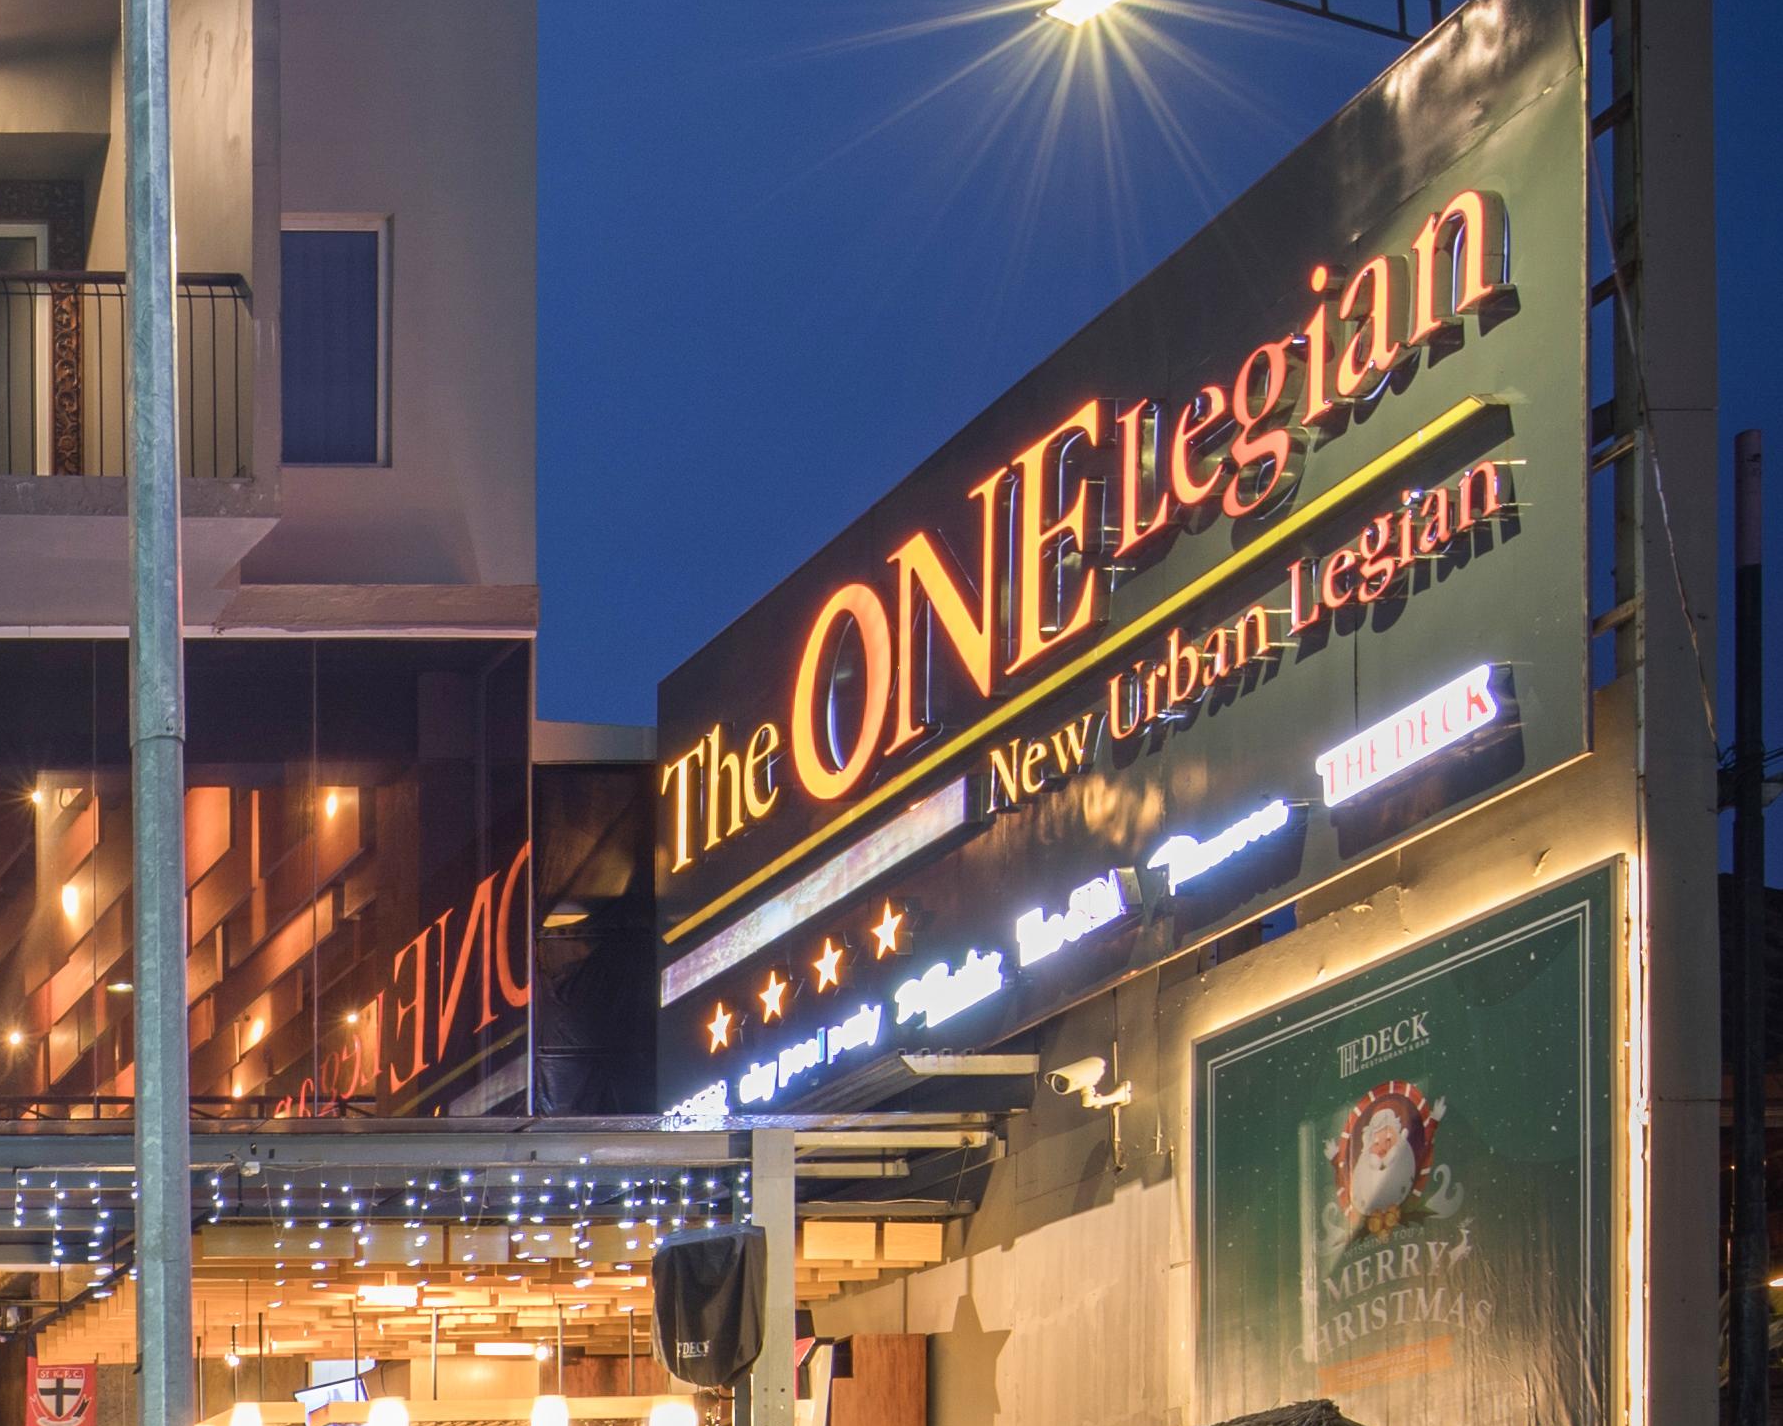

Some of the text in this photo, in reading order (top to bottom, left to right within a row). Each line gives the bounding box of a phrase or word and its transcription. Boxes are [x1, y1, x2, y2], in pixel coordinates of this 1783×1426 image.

[662, 189, 1493, 873] The ONE Legian
[988, 461, 1502, 814] New Urban Legian
[1325, 684, 1490, 795] THE DECK
[1337, 1011, 1430, 1079] THE DECK
[1323, 1241, 1449, 1310] MERRY
[1288, 1286, 1493, 1374] CHRISTMAS
